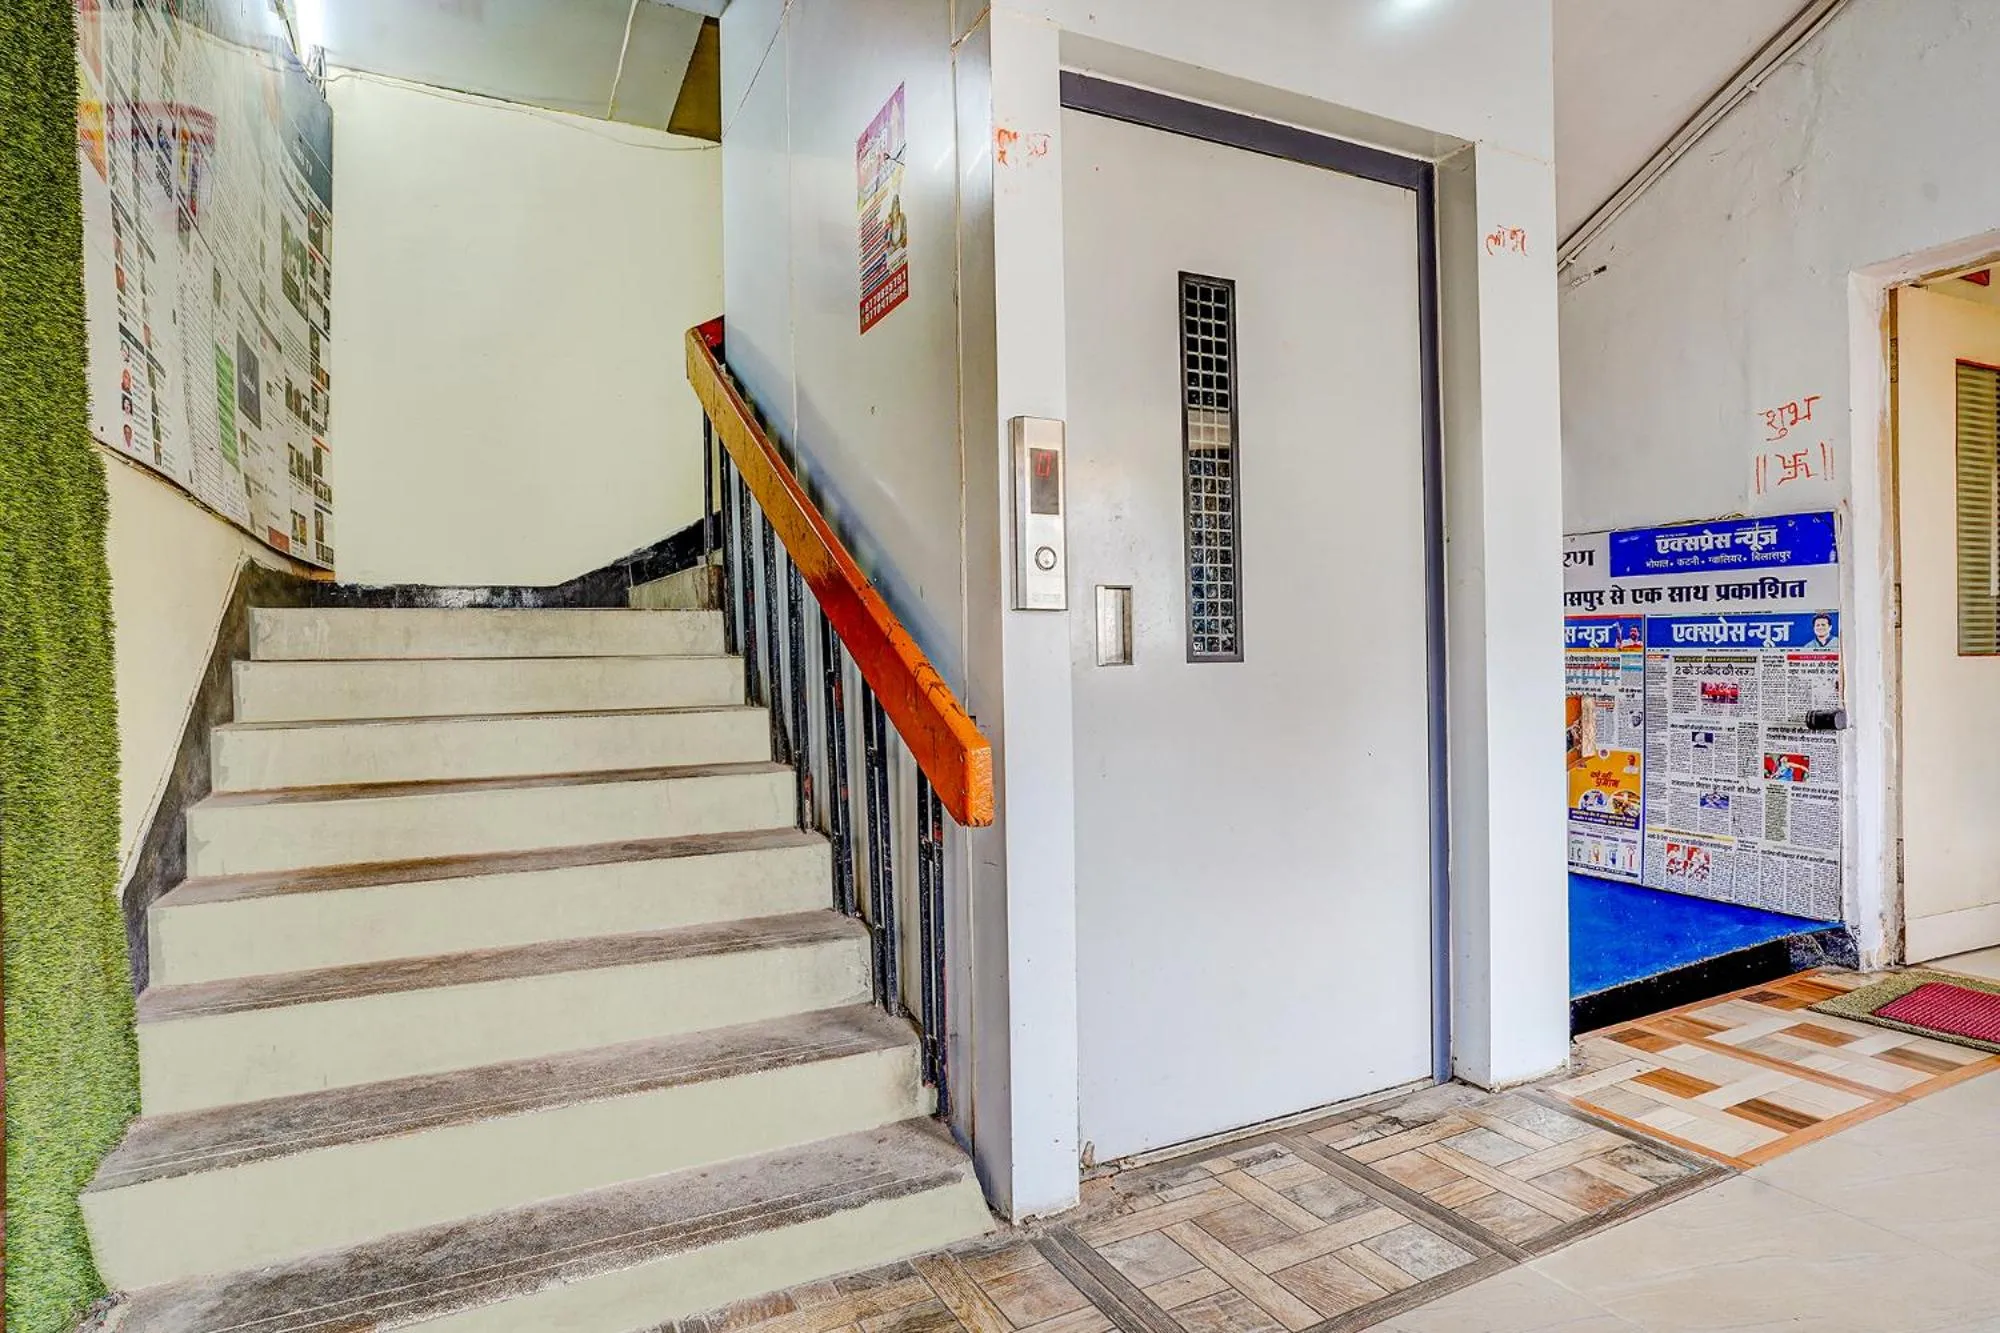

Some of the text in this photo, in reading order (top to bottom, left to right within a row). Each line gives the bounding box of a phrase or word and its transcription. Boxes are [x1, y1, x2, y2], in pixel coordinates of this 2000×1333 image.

[1655, 527, 1778, 554] एक्सप्रेस न्यूज
[1610, 585, 1625, 605] से
[1631, 586, 1662, 604] एक
[1667, 585, 1707, 602] साथ
[1714, 577, 1807, 601] प्रकाशित
[1577, 625, 1613, 647] न्यूज
[1671, 617, 1794, 648] एक्सप्रेस न्यूज
